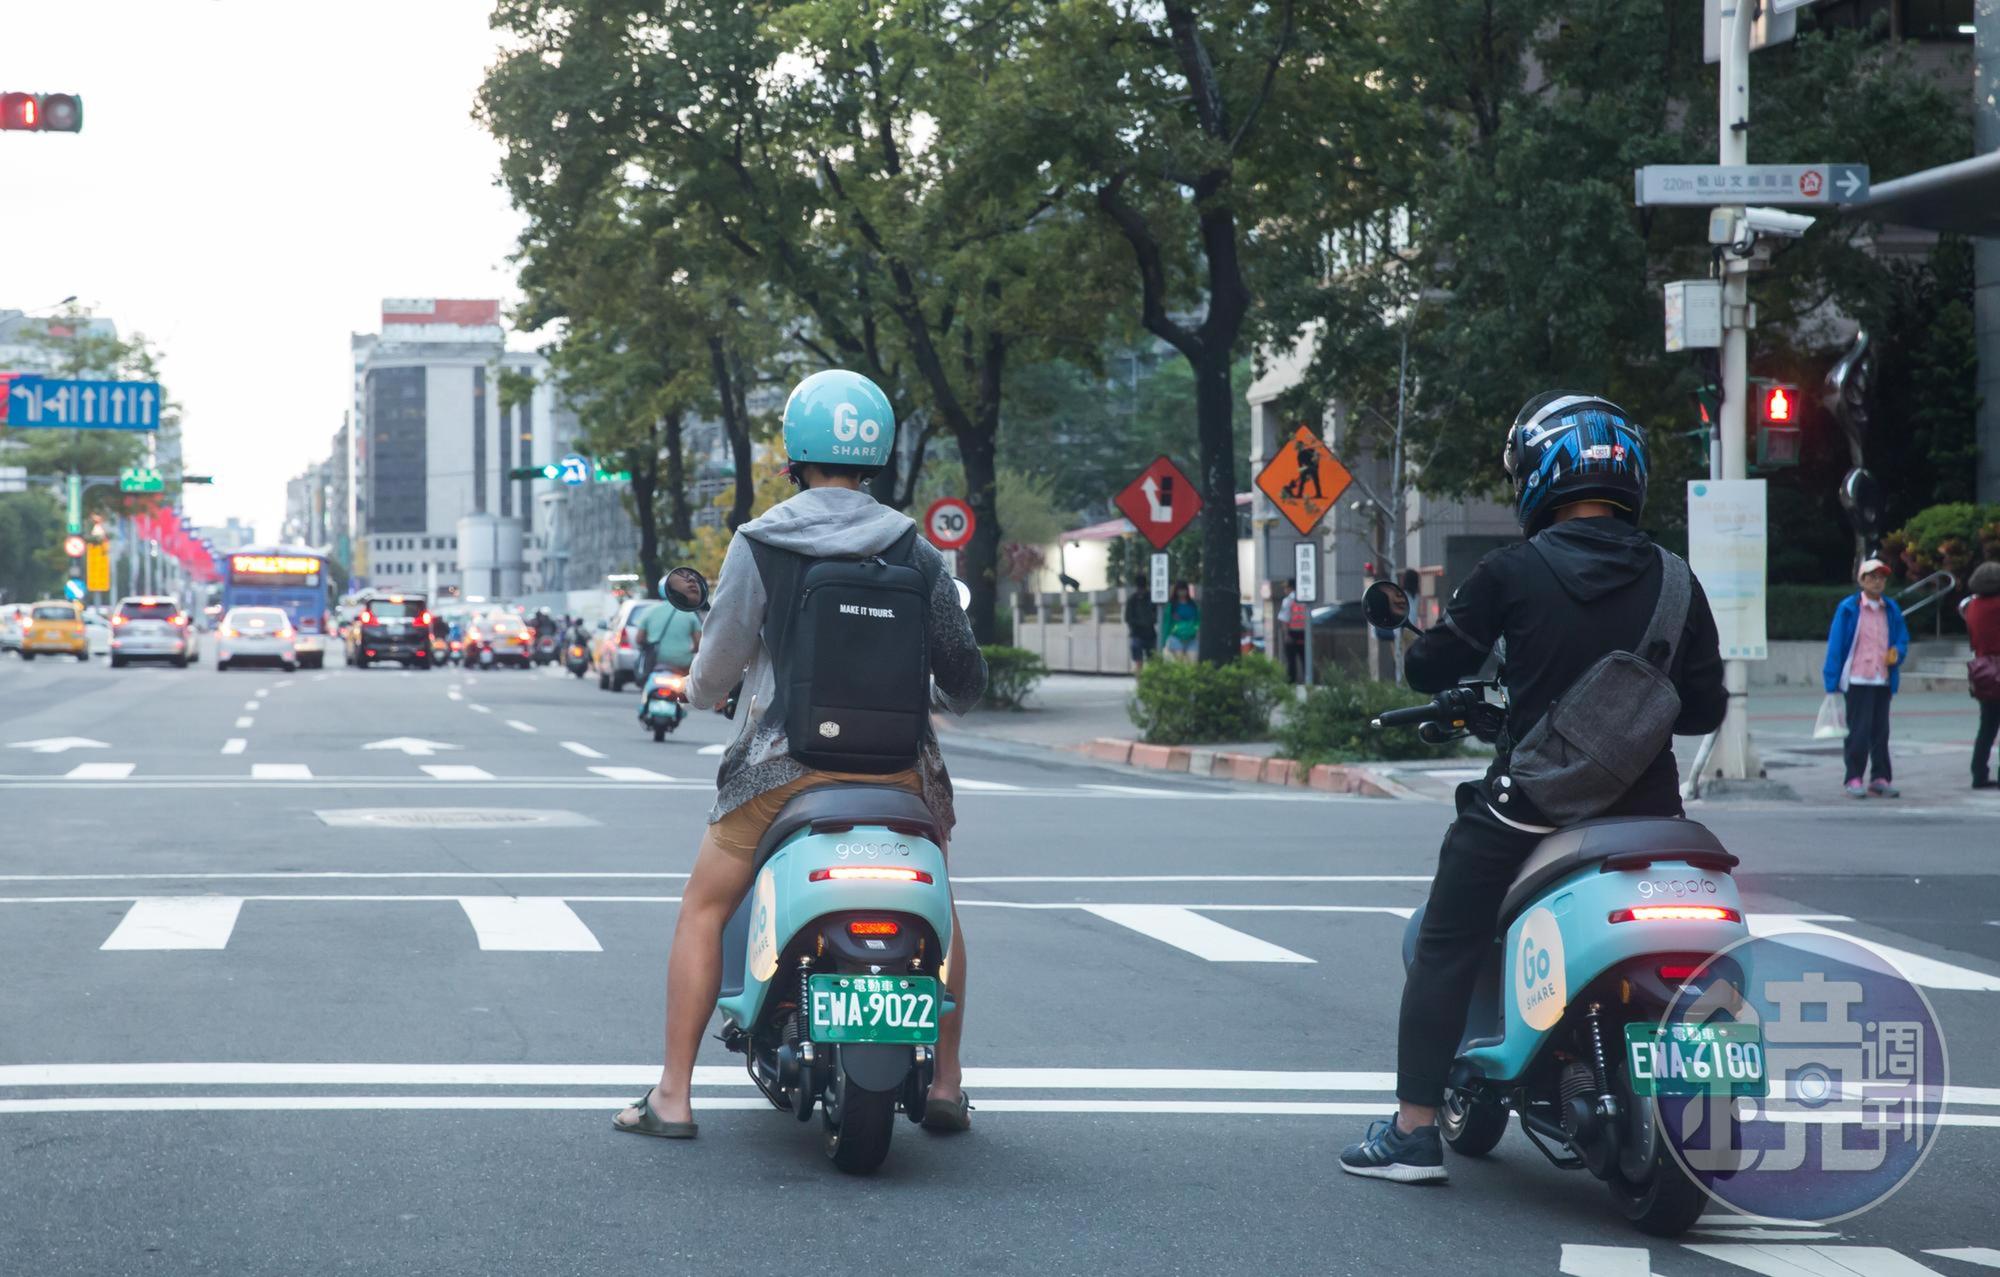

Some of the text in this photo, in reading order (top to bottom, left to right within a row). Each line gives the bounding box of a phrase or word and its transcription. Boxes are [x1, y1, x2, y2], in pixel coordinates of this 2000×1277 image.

[1663, 177, 1693, 192] 220m
[833, 402, 880, 443] Go
[832, 445, 878, 456] SHARE
[937, 514, 964, 533] 30
[840, 604, 895, 618] MAKE IT YOURS.
[836, 842, 910, 860] gogoro
[1638, 878, 1717, 899] gogoro
[1523, 937, 1550, 989] Go
[853, 978, 894, 992] 電動車
[1526, 982, 1556, 1010] SHARE
